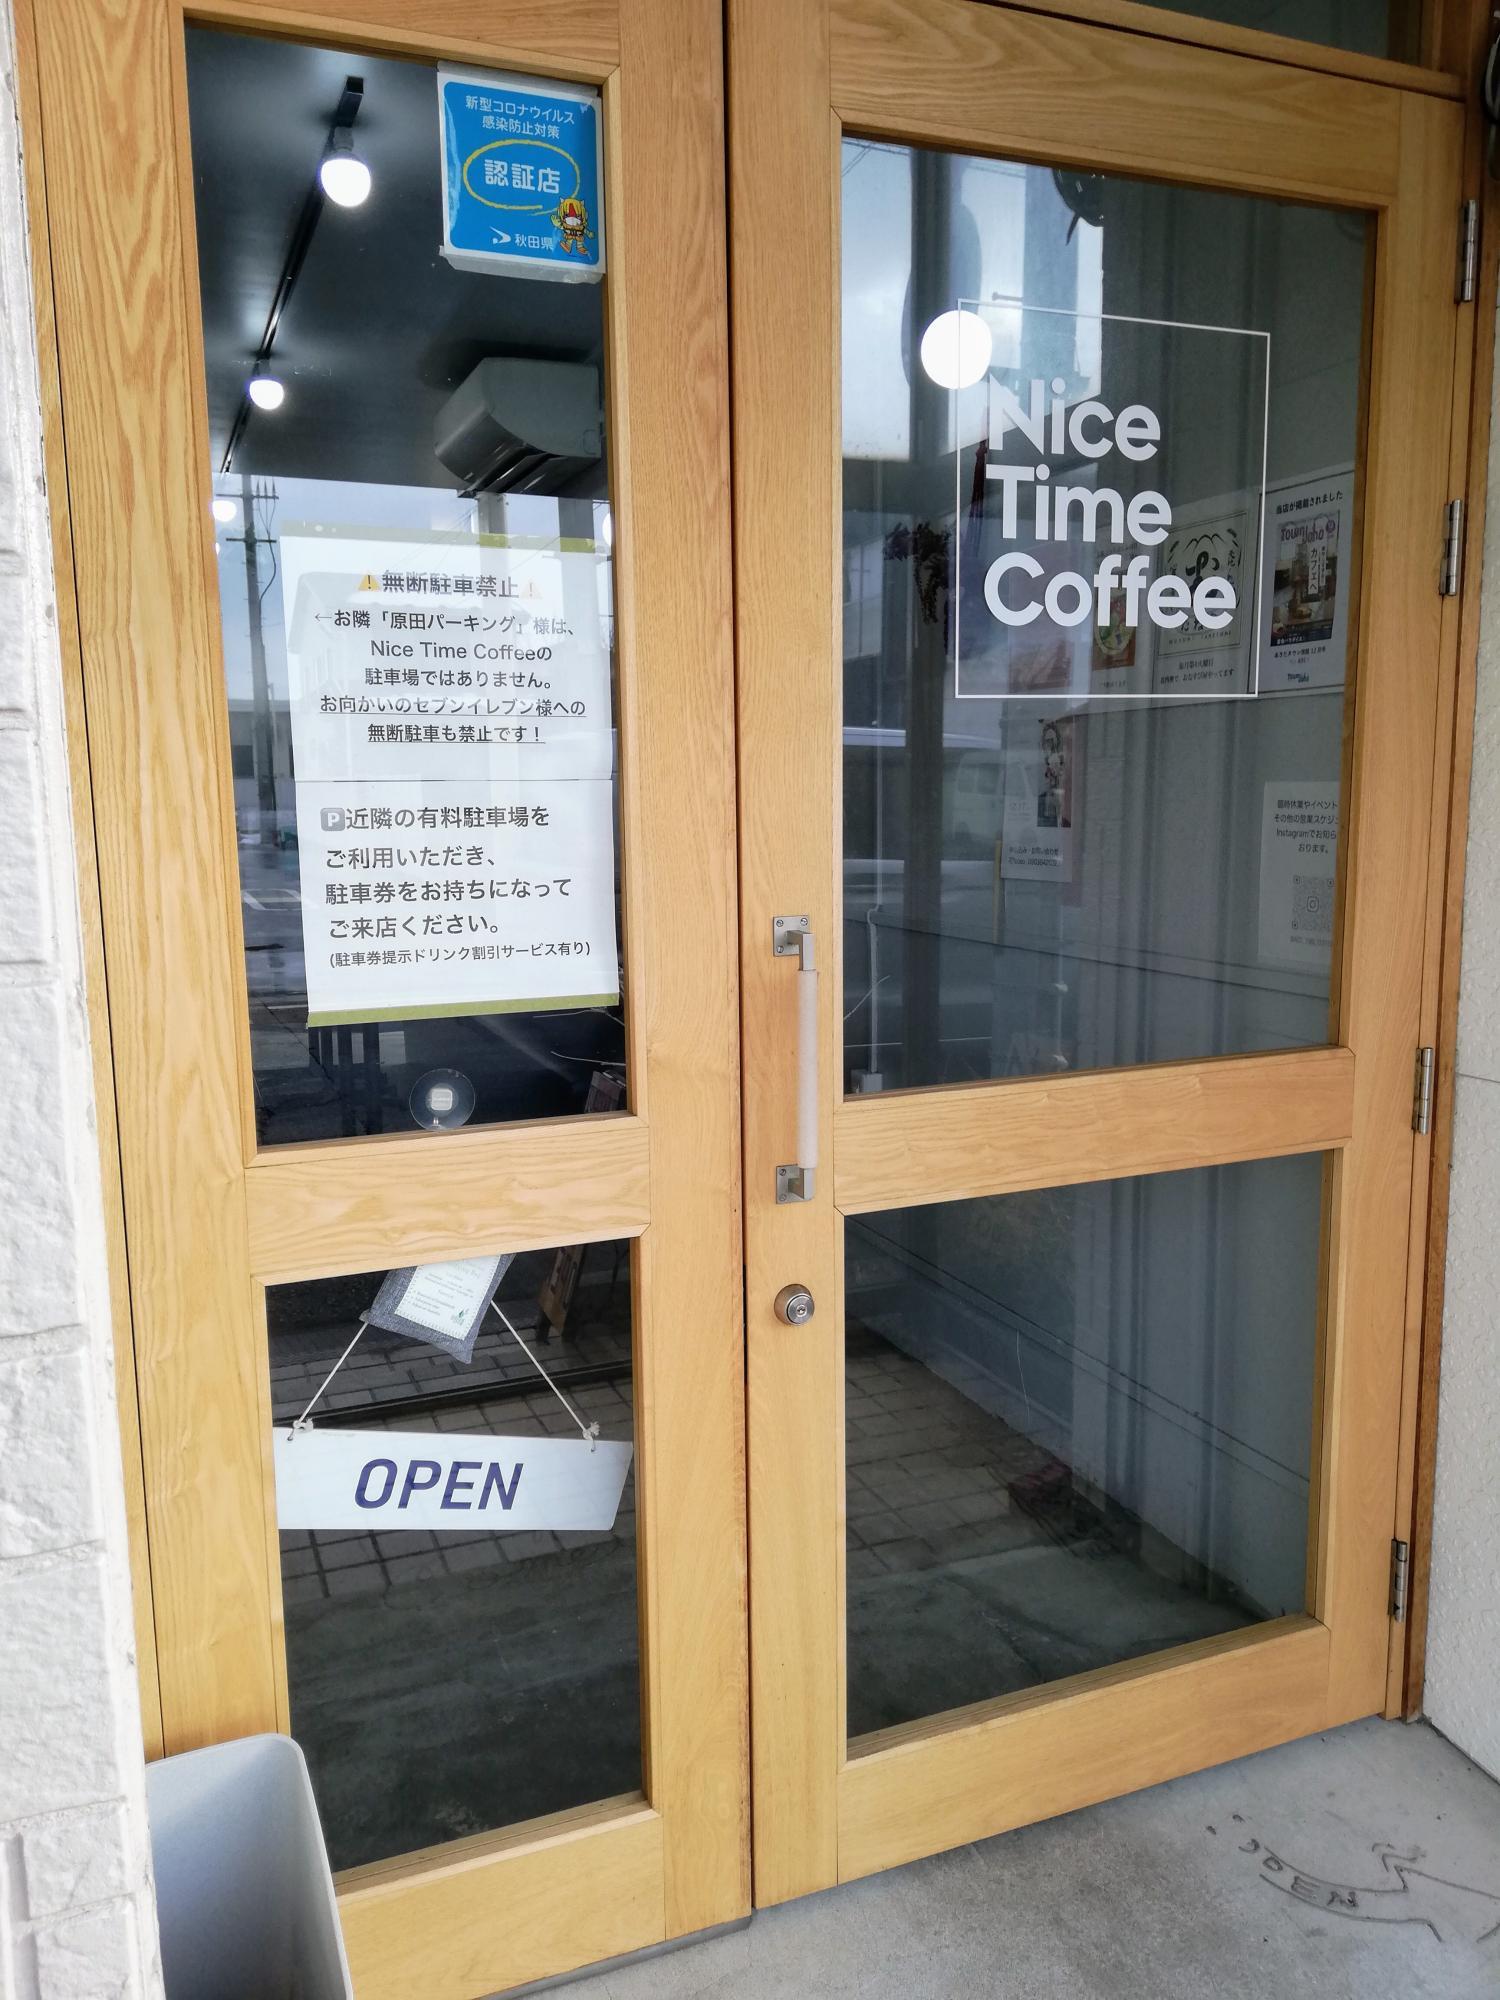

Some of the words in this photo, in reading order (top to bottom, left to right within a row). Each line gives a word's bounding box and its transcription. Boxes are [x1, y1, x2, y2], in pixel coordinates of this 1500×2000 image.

[465, 95, 576, 125] 新型コロナウイルス
[482, 116, 560, 139] 感染防止対策
[484, 159, 561, 194] 認証店
[514, 233, 554, 250] 秋田県
[988, 373, 1161, 461] Nice
[986, 463, 1172, 546] Time
[382, 569, 520, 599] 無断駐車禁止
[984, 551, 1237, 630] Coffee
[370, 640, 414, 658] Nice
[420, 641, 467, 660] Time
[365, 668, 552, 689] 駐車場ではありません。
[320, 695, 587, 716] お向かいのセブンイレブン様への
[326, 845, 499, 870] ご利用いただき、
[325, 877, 572, 905] 駐車券をお持ちになって
[329, 914, 502, 940] ご来店ください。
[329, 940, 591, 969] (駐車券提示ドリンク割引サービス有り)
[354, 1458, 524, 1511] OPEN
